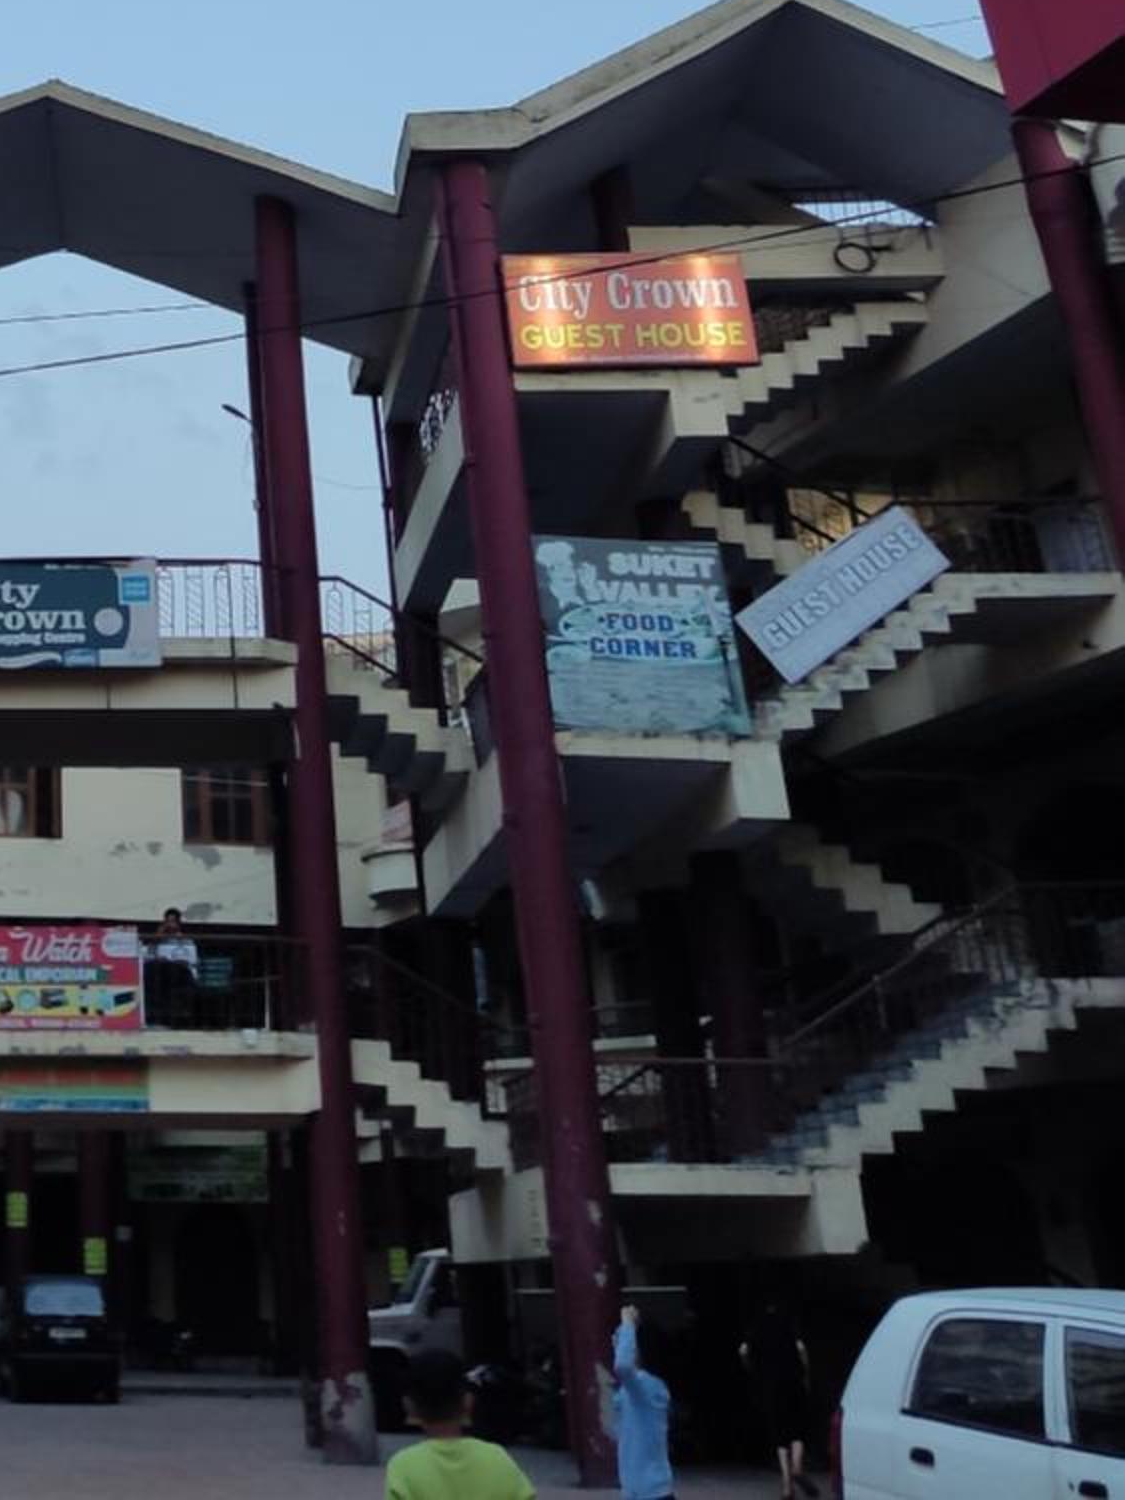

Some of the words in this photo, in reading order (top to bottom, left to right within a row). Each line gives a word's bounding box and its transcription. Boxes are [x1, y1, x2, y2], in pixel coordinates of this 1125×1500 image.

[518, 274, 591, 319] City
[607, 272, 738, 309] Crown
[521, 323, 624, 349] GUEST
[636, 321, 748, 347] HOUSE
[607, 552, 716, 578] SUKET
[762, 579, 841, 649] GUEST
[837, 522, 922, 596] HOUSE
[606, 612, 674, 632] FOOD
[589, 637, 697, 658] CORNER
[8, 927, 93, 962] Watch
